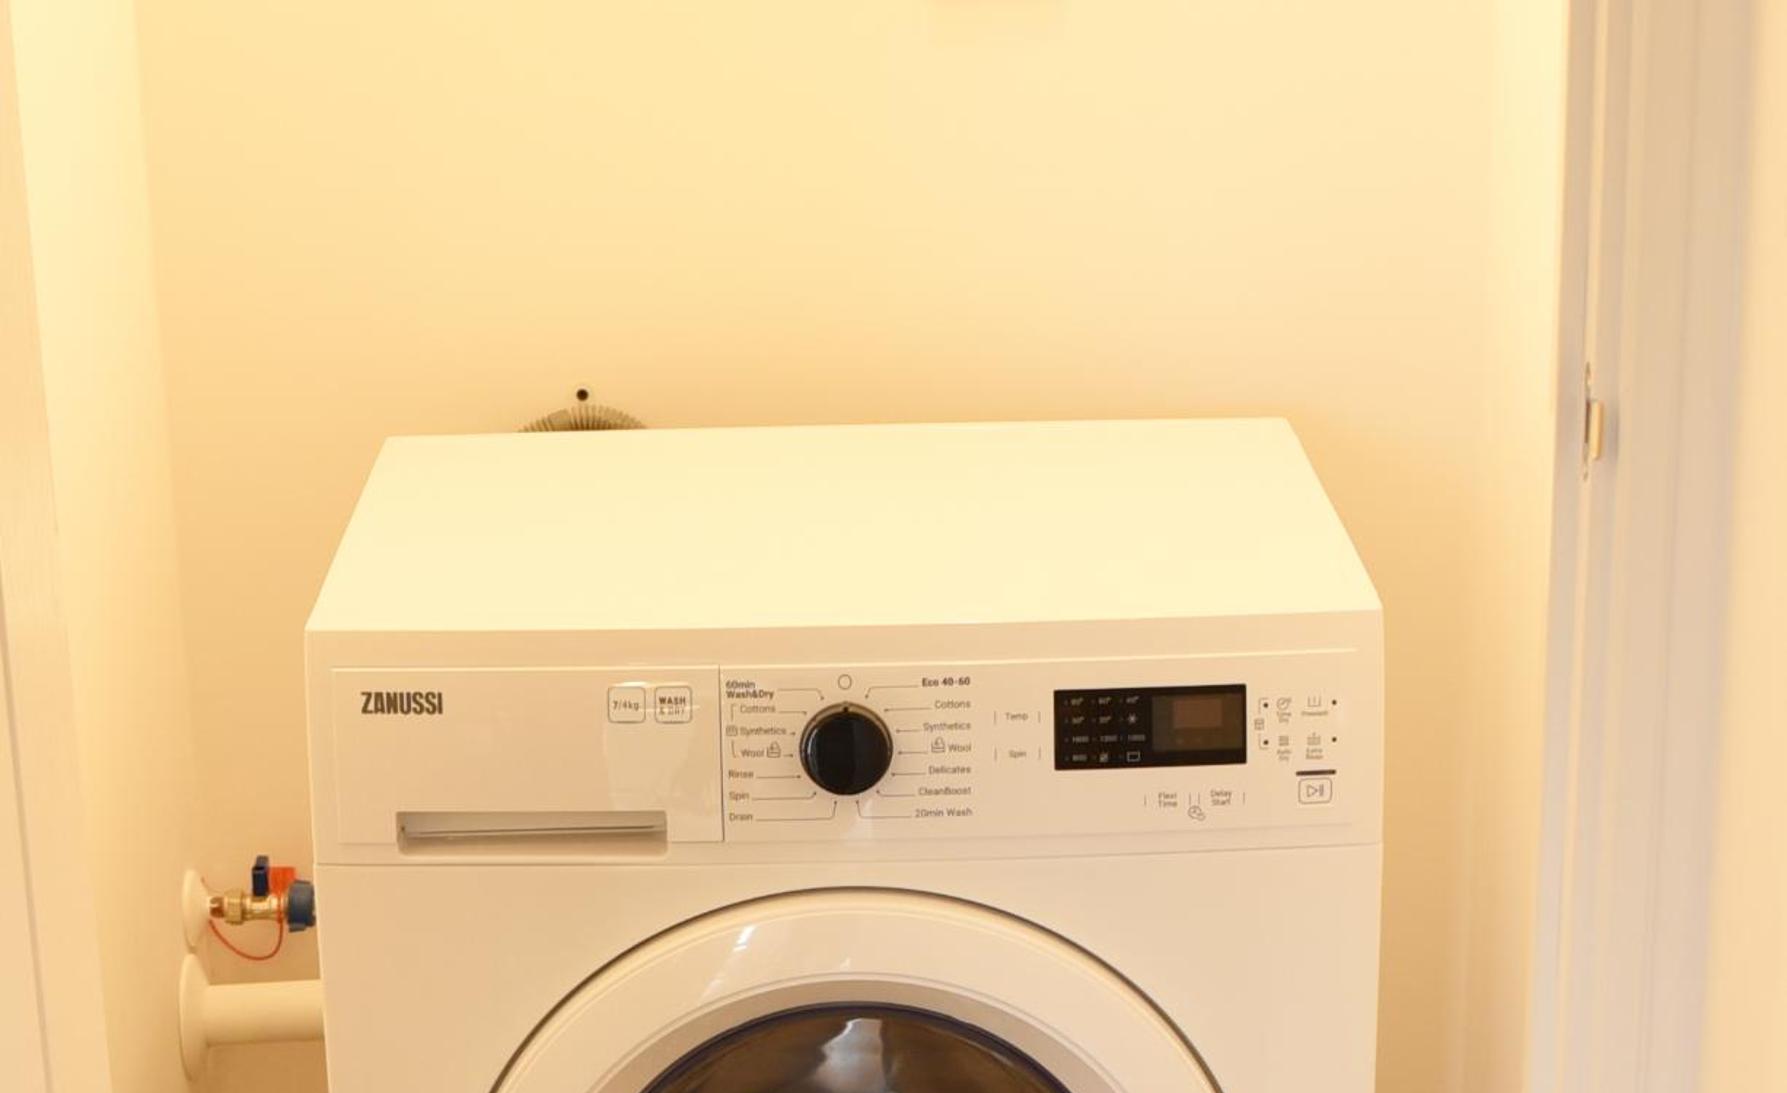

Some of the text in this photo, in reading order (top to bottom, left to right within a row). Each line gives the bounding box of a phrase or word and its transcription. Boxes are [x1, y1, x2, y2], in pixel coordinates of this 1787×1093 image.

[726, 680, 756, 689] 60min
[922, 677, 971, 687] Eco 40-60
[726, 690, 774, 700] Wash&Dry
[361, 692, 443, 715] ZANUSSI
[659, 696, 686, 705] WASH
[935, 699, 971, 709] Cottons
[740, 705, 776, 713] Cottons
[1006, 712, 1028, 722] Temp
[740, 726, 787, 737] Synthetics
[923, 721, 971, 733] Synthetics
[948, 743, 972, 753] Wool
[741, 749, 765, 758] Wool
[728, 769, 754, 779] Rinse
[928, 765, 972, 775] Delicates
[918, 786, 972, 796] CleanBoost
[729, 791, 750, 802] Spin
[729, 812, 753, 822] Drain
[915, 807, 973, 818] 20min Wash
